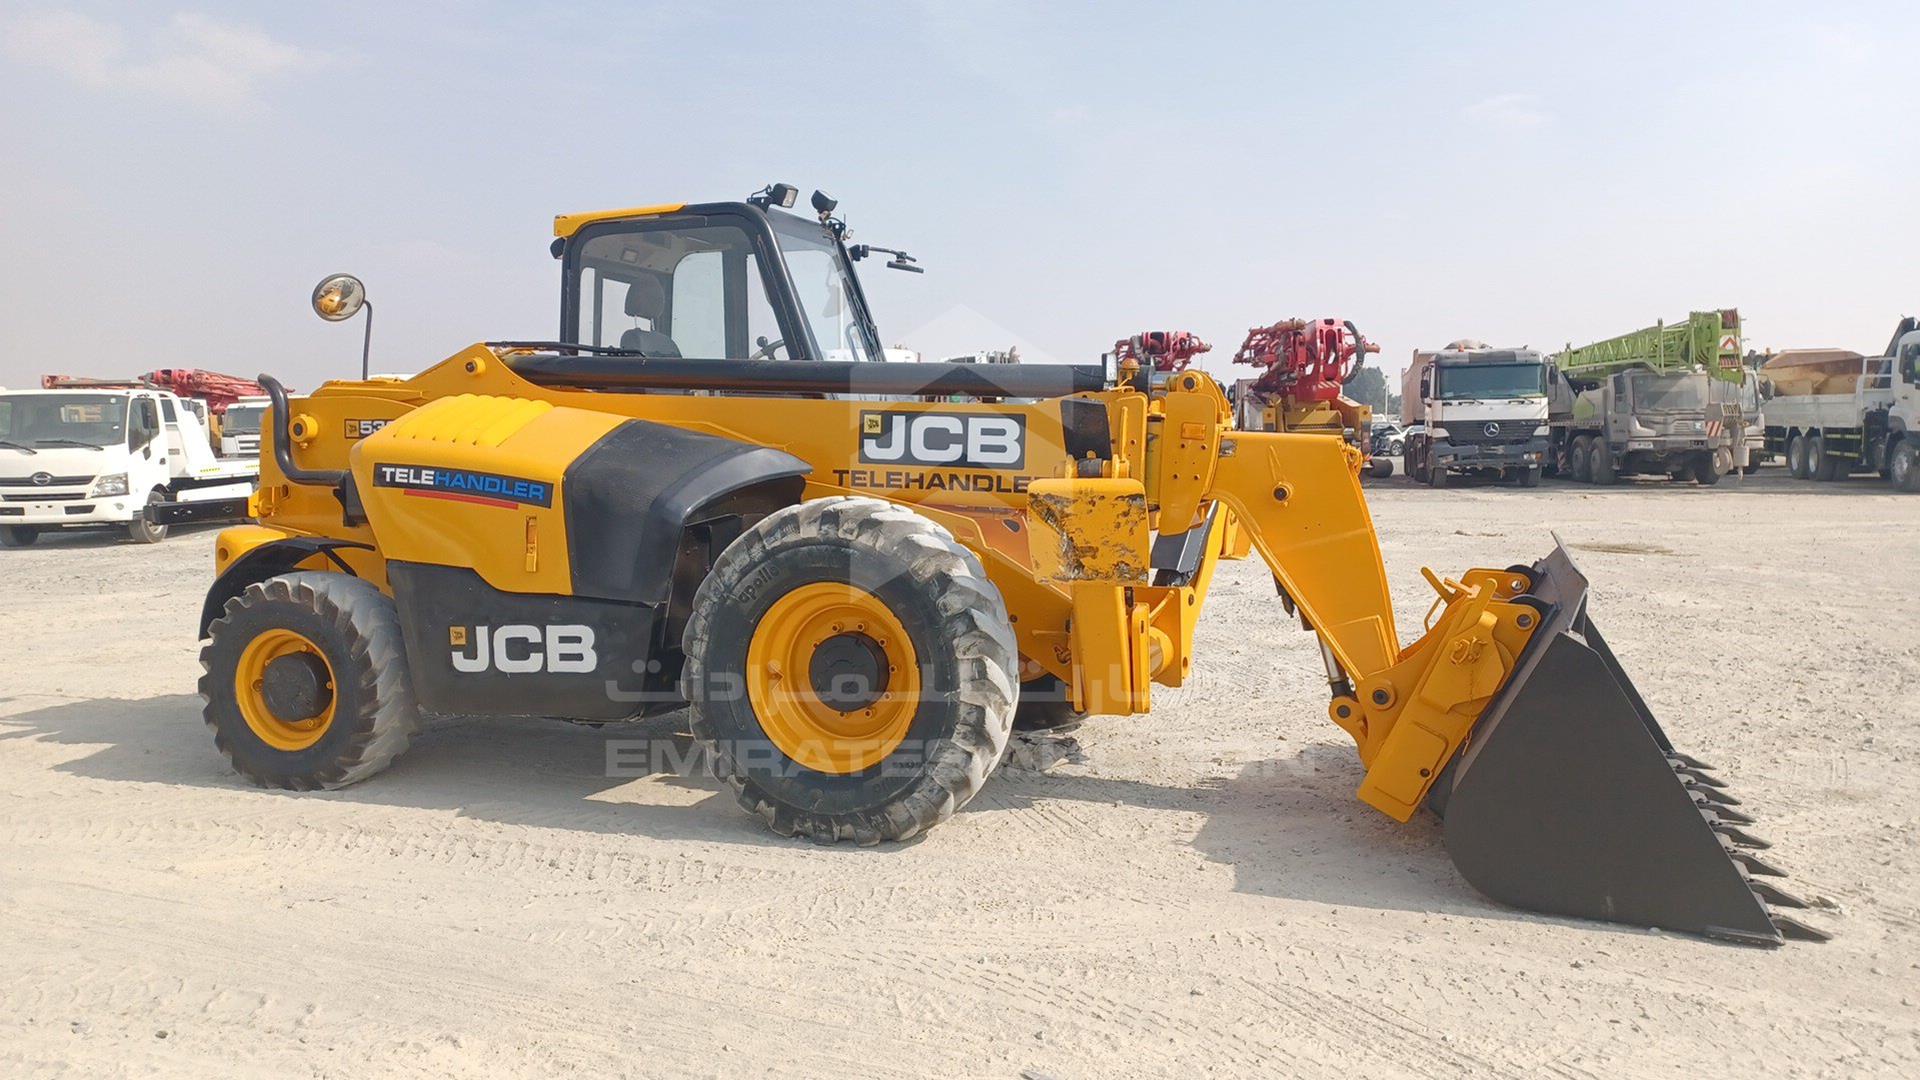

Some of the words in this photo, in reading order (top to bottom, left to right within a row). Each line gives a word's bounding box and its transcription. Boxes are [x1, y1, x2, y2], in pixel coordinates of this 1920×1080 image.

[360, 420, 392, 434] 53
[863, 414, 1021, 464] JCB
[381, 467, 545, 499] TELEHANDLER
[833, 470, 1050, 494] TELEHANDLE
[736, 564, 781, 604] apollo
[451, 625, 598, 673] JCB
